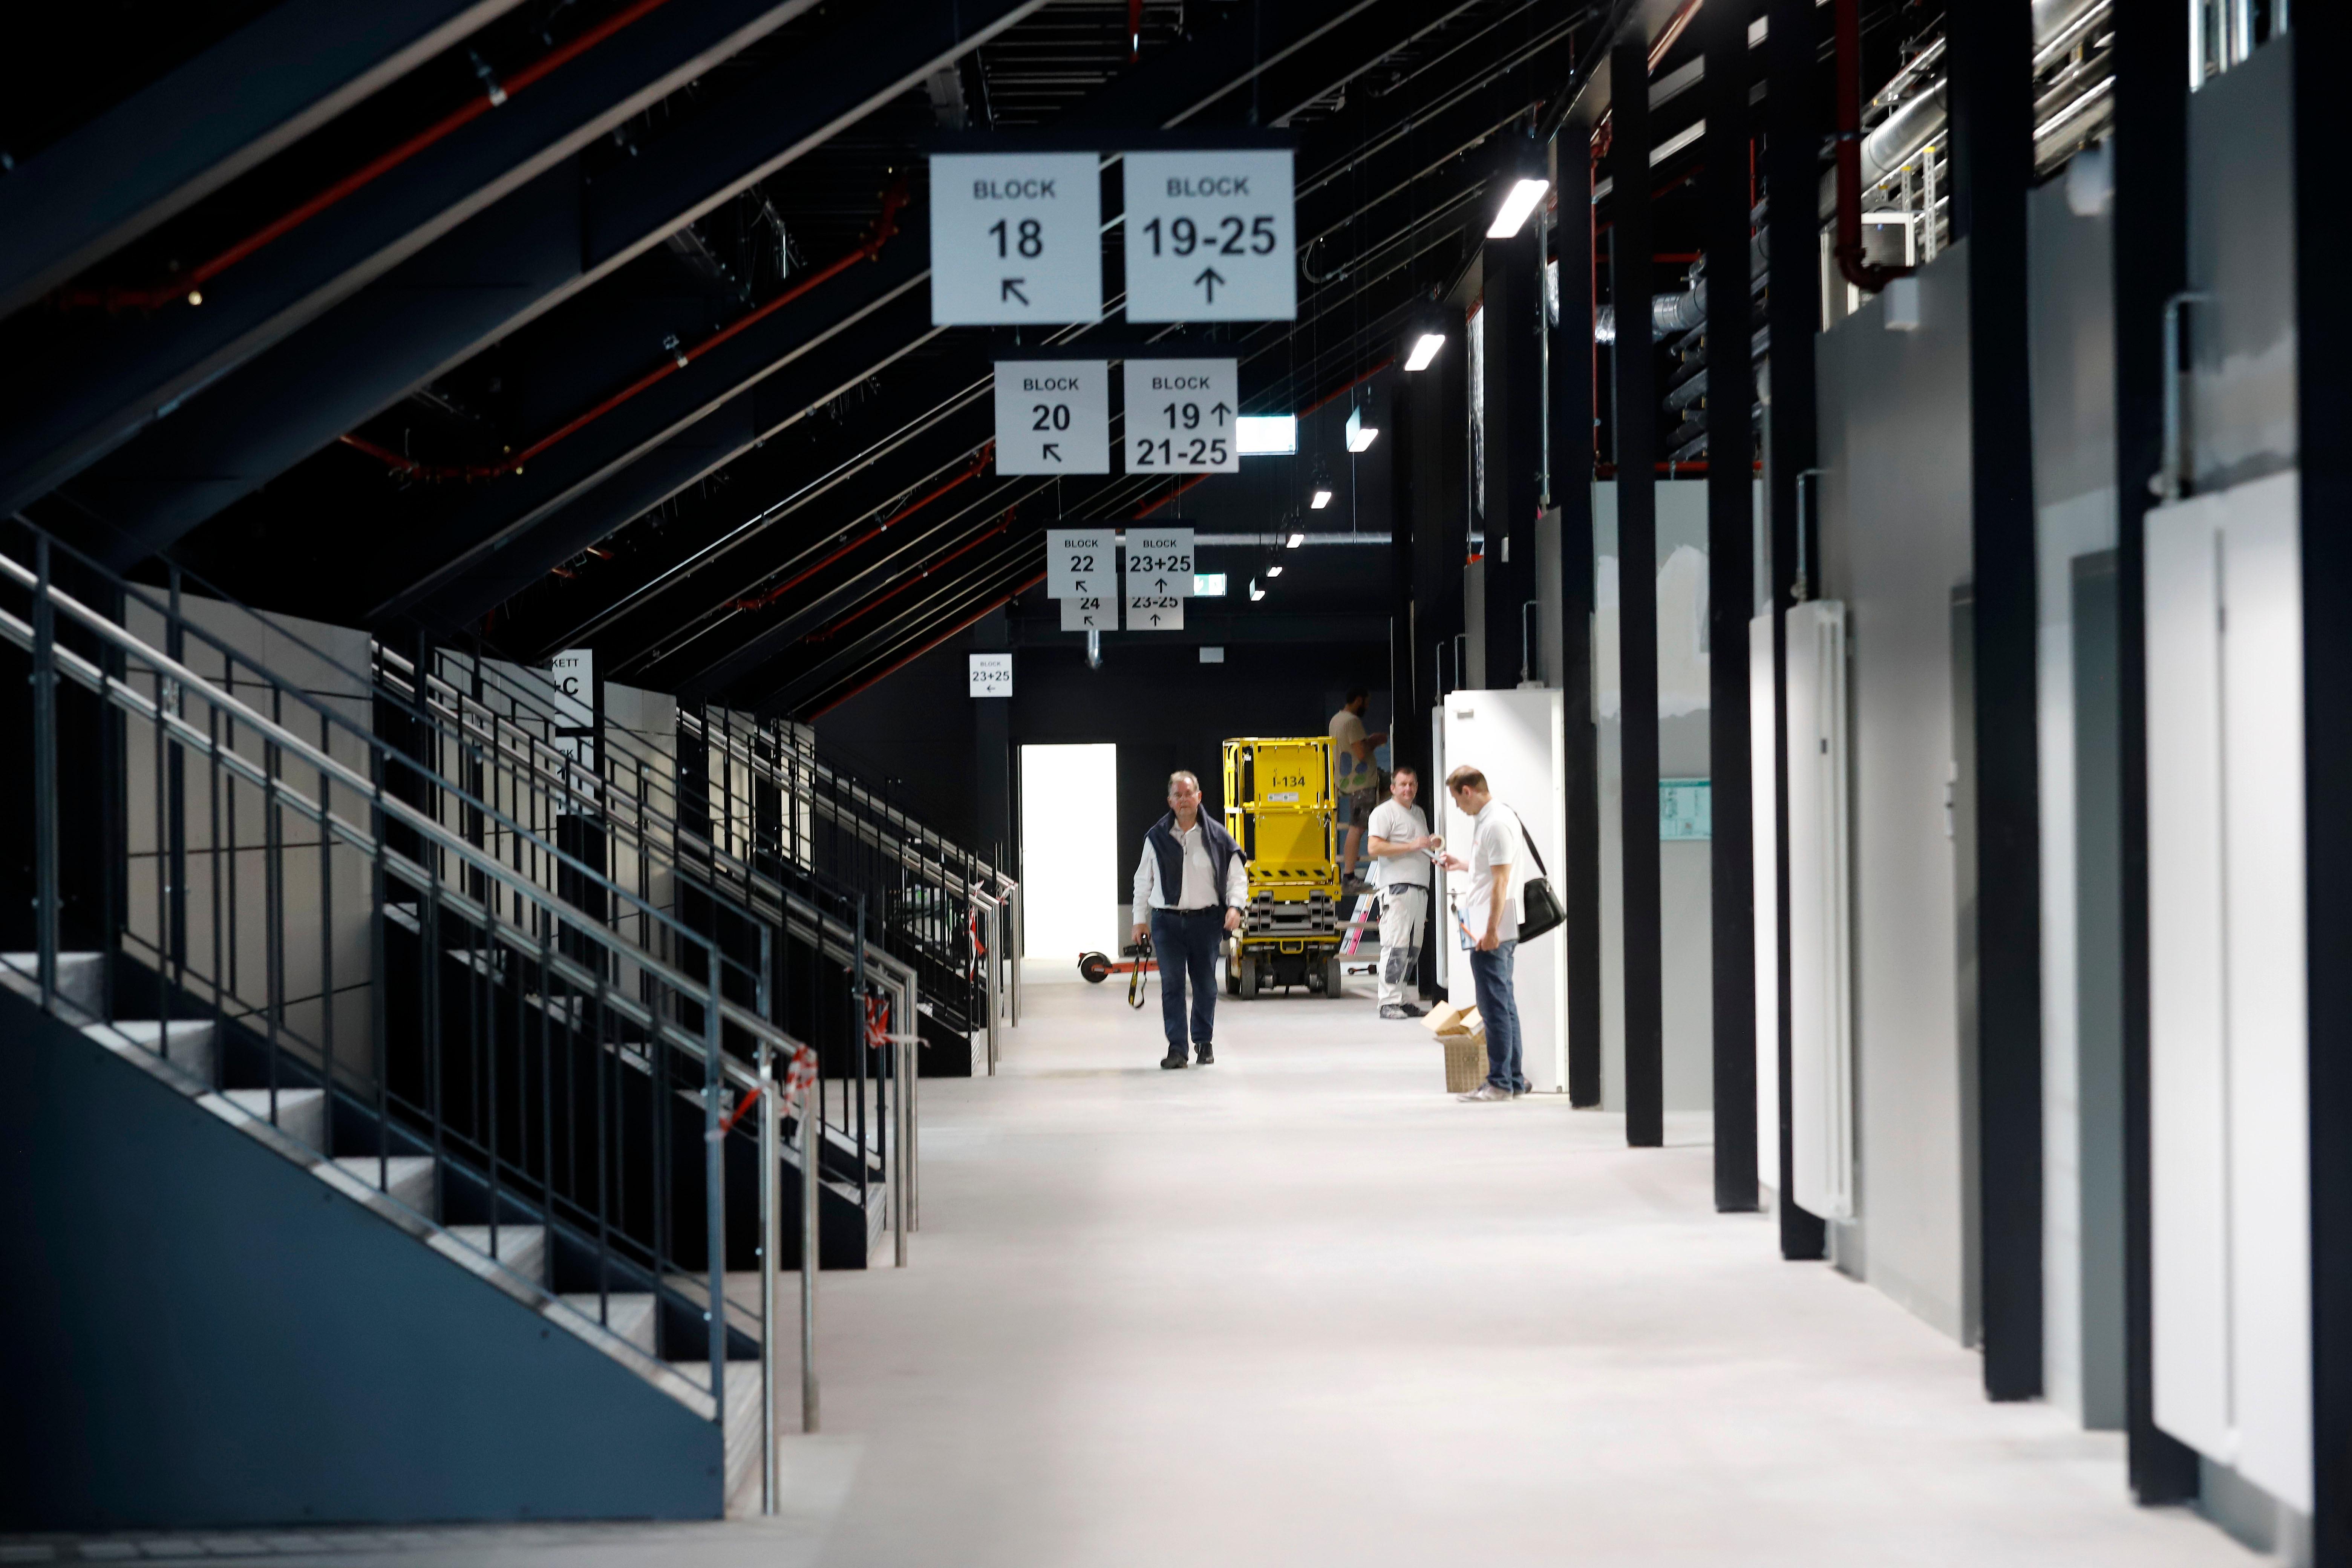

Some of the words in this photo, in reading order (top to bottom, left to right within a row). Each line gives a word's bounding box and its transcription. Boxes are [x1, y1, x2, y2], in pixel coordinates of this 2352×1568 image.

[973, 179, 1055, 200] BLOCK
[1165, 176, 1249, 198] BLOCK
[988, 218, 1043, 259] 18
[1143, 215, 1277, 257] 19-25
[1023, 378, 1079, 391] BLOCK
[1152, 377, 1210, 390] BLOCK
[1032, 404, 1070, 431] 20
[1163, 403, 1200, 429] 19
[1137, 438, 1227, 466] 21-25
[1065, 539, 1098, 548] BLOCK
[1143, 539, 1177, 548] BLOCK
[1070, 556, 1094, 572] 22
[1130, 556, 1191, 572] 23+25
[1080, 597, 1100, 610] 24
[1132, 597, 1178, 608] 23-25
[972, 671, 1009, 681] 23+25
[1273, 776, 1305, 787] I-134
